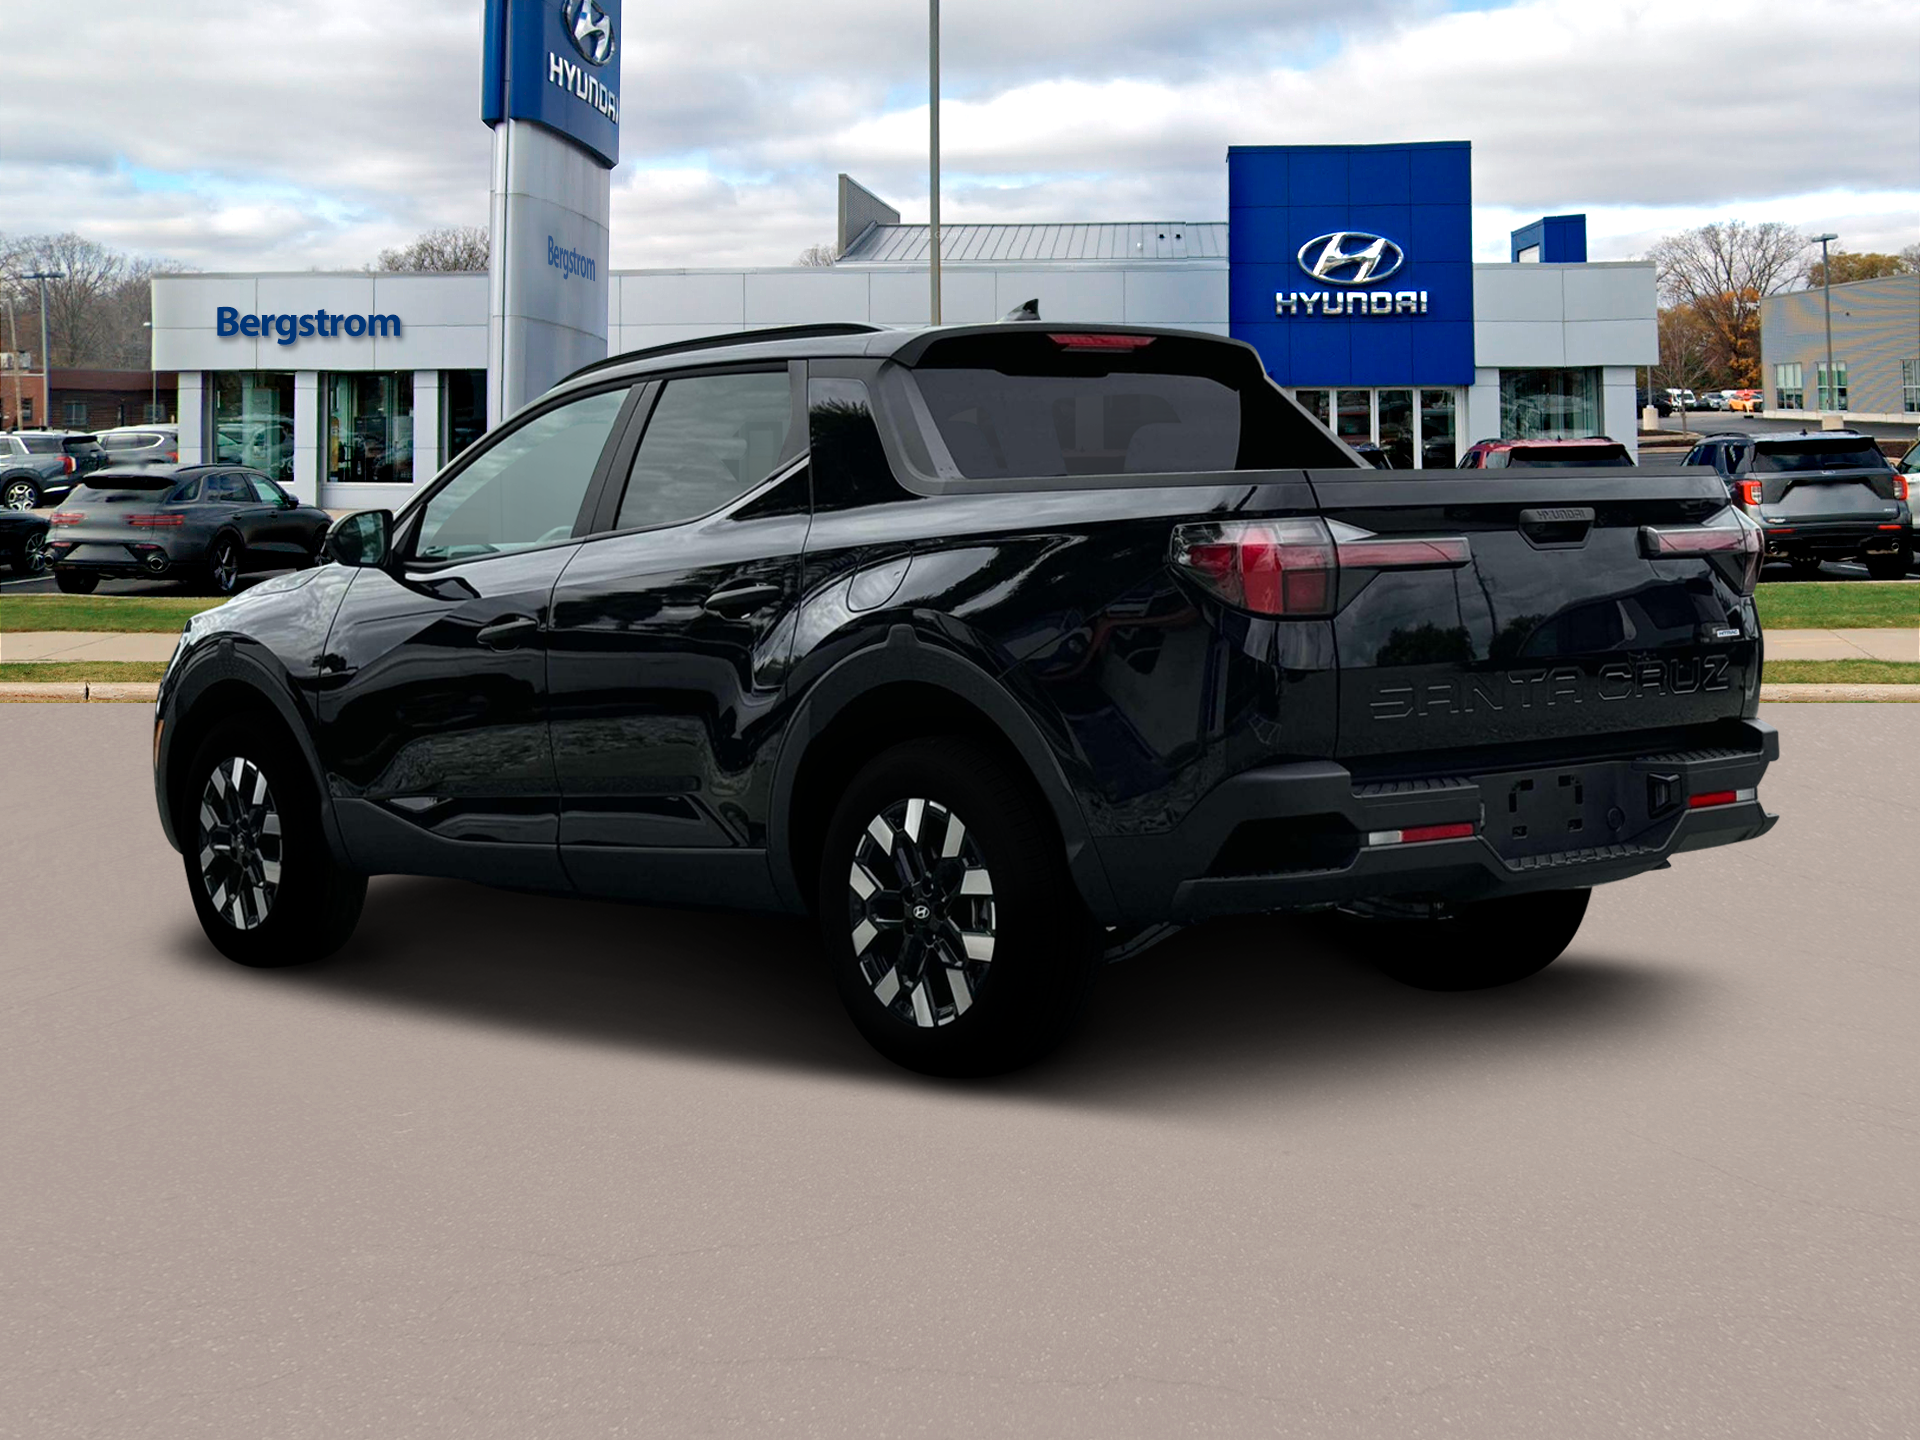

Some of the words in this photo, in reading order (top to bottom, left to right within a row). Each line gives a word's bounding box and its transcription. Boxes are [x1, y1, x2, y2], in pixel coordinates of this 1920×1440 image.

[549, 52, 619, 124] HYUNDAI
[548, 235, 596, 281] Bergstrom
[216, 306, 401, 346] Bergstrom
[1276, 291, 1428, 315] HYUNDAI
[1370, 666, 1584, 719] SANTA
[1599, 653, 1729, 700] CRUZ
